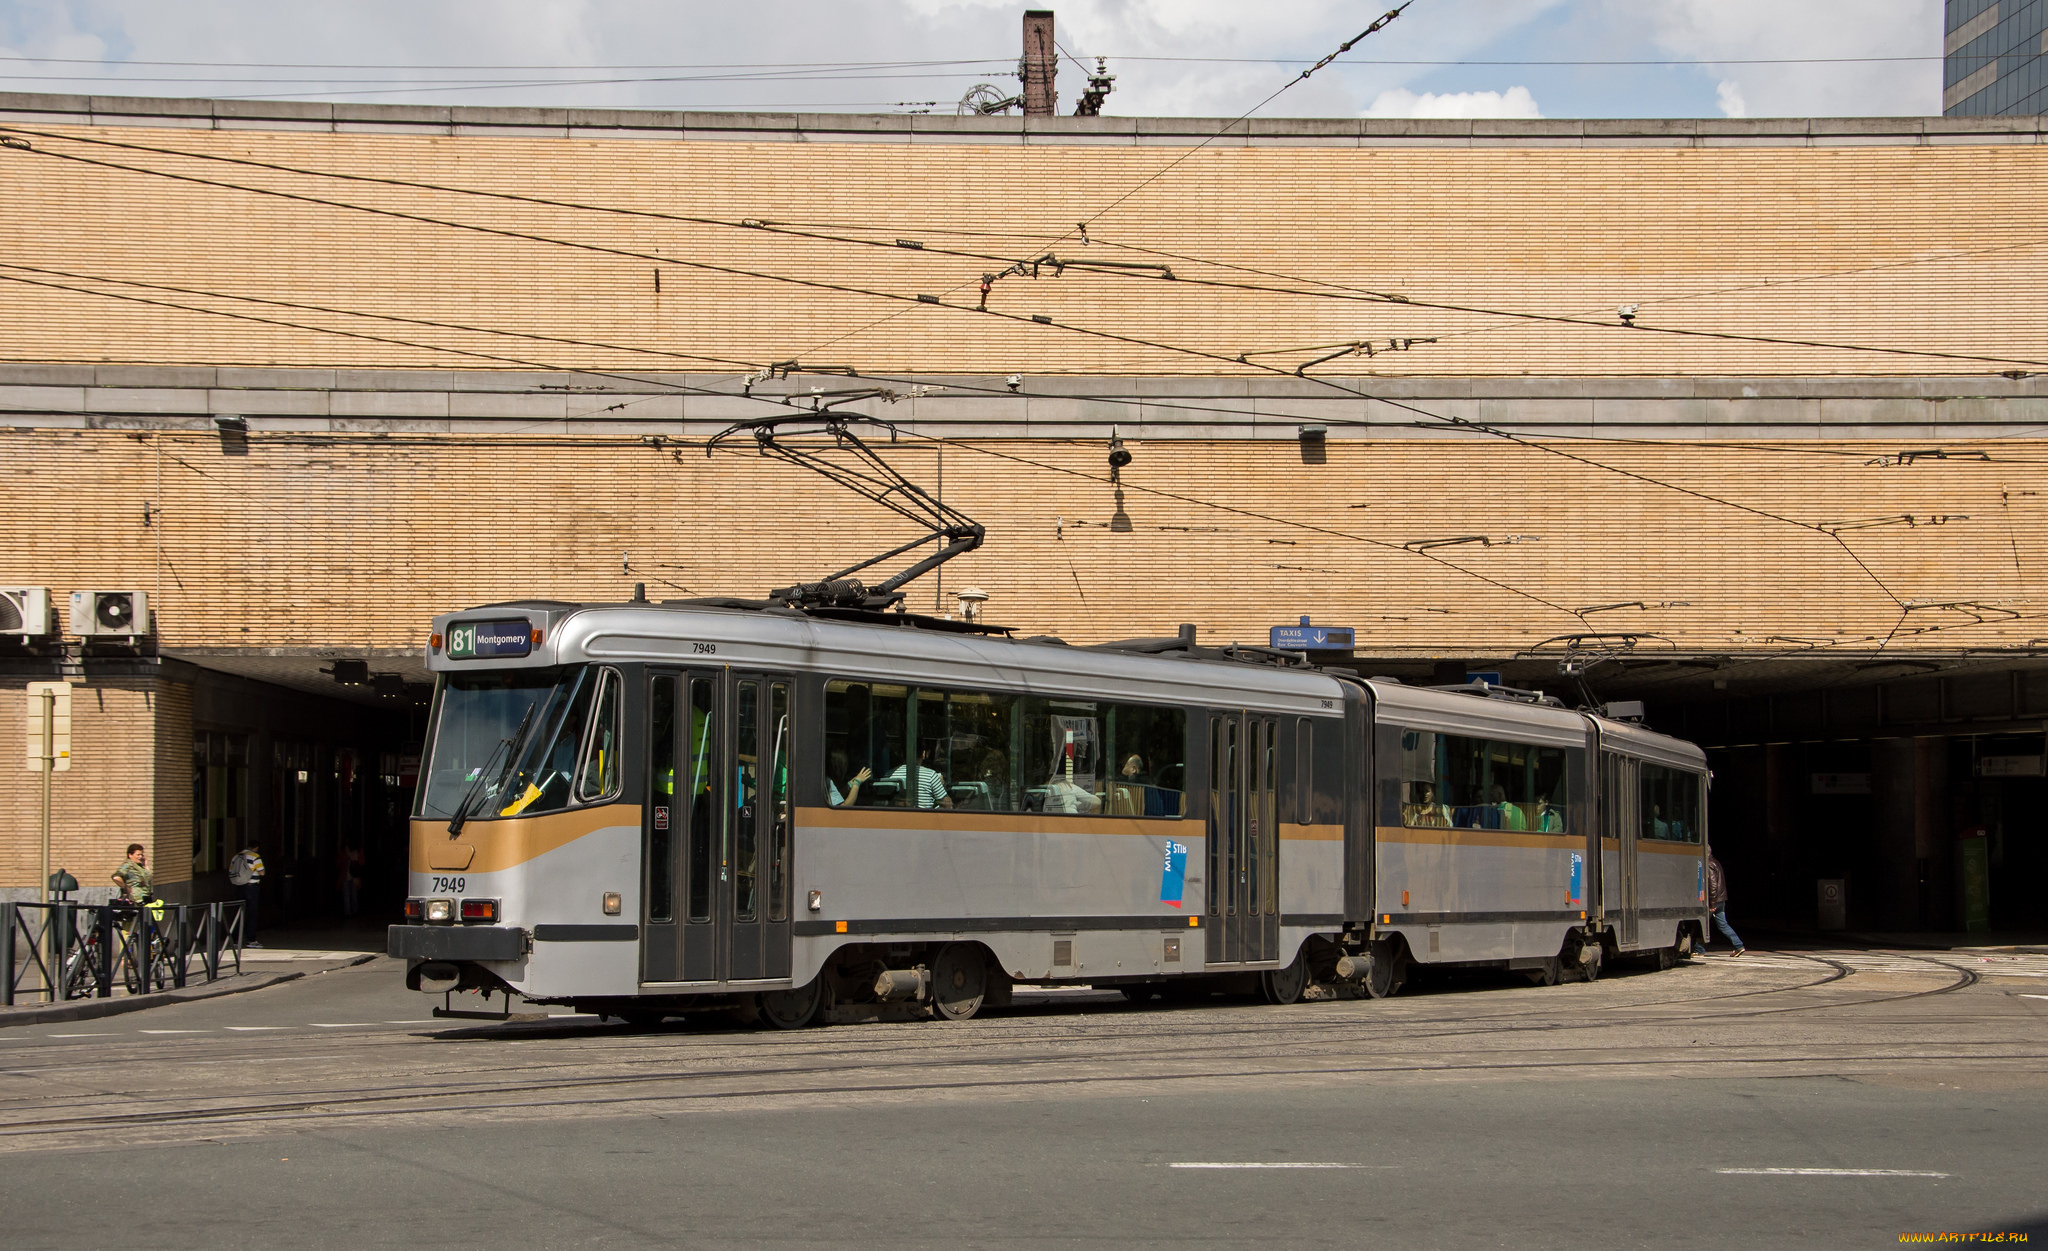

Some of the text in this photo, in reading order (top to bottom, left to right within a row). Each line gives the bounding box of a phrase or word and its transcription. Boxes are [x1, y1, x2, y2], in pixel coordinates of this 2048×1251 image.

[1280, 629, 1302, 637] TAXIS
[452, 629, 526, 651] 81 Montgomery
[692, 642, 716, 654] 7949
[1173, 843, 1187, 854] STIB
[432, 876, 466, 893] 7949
